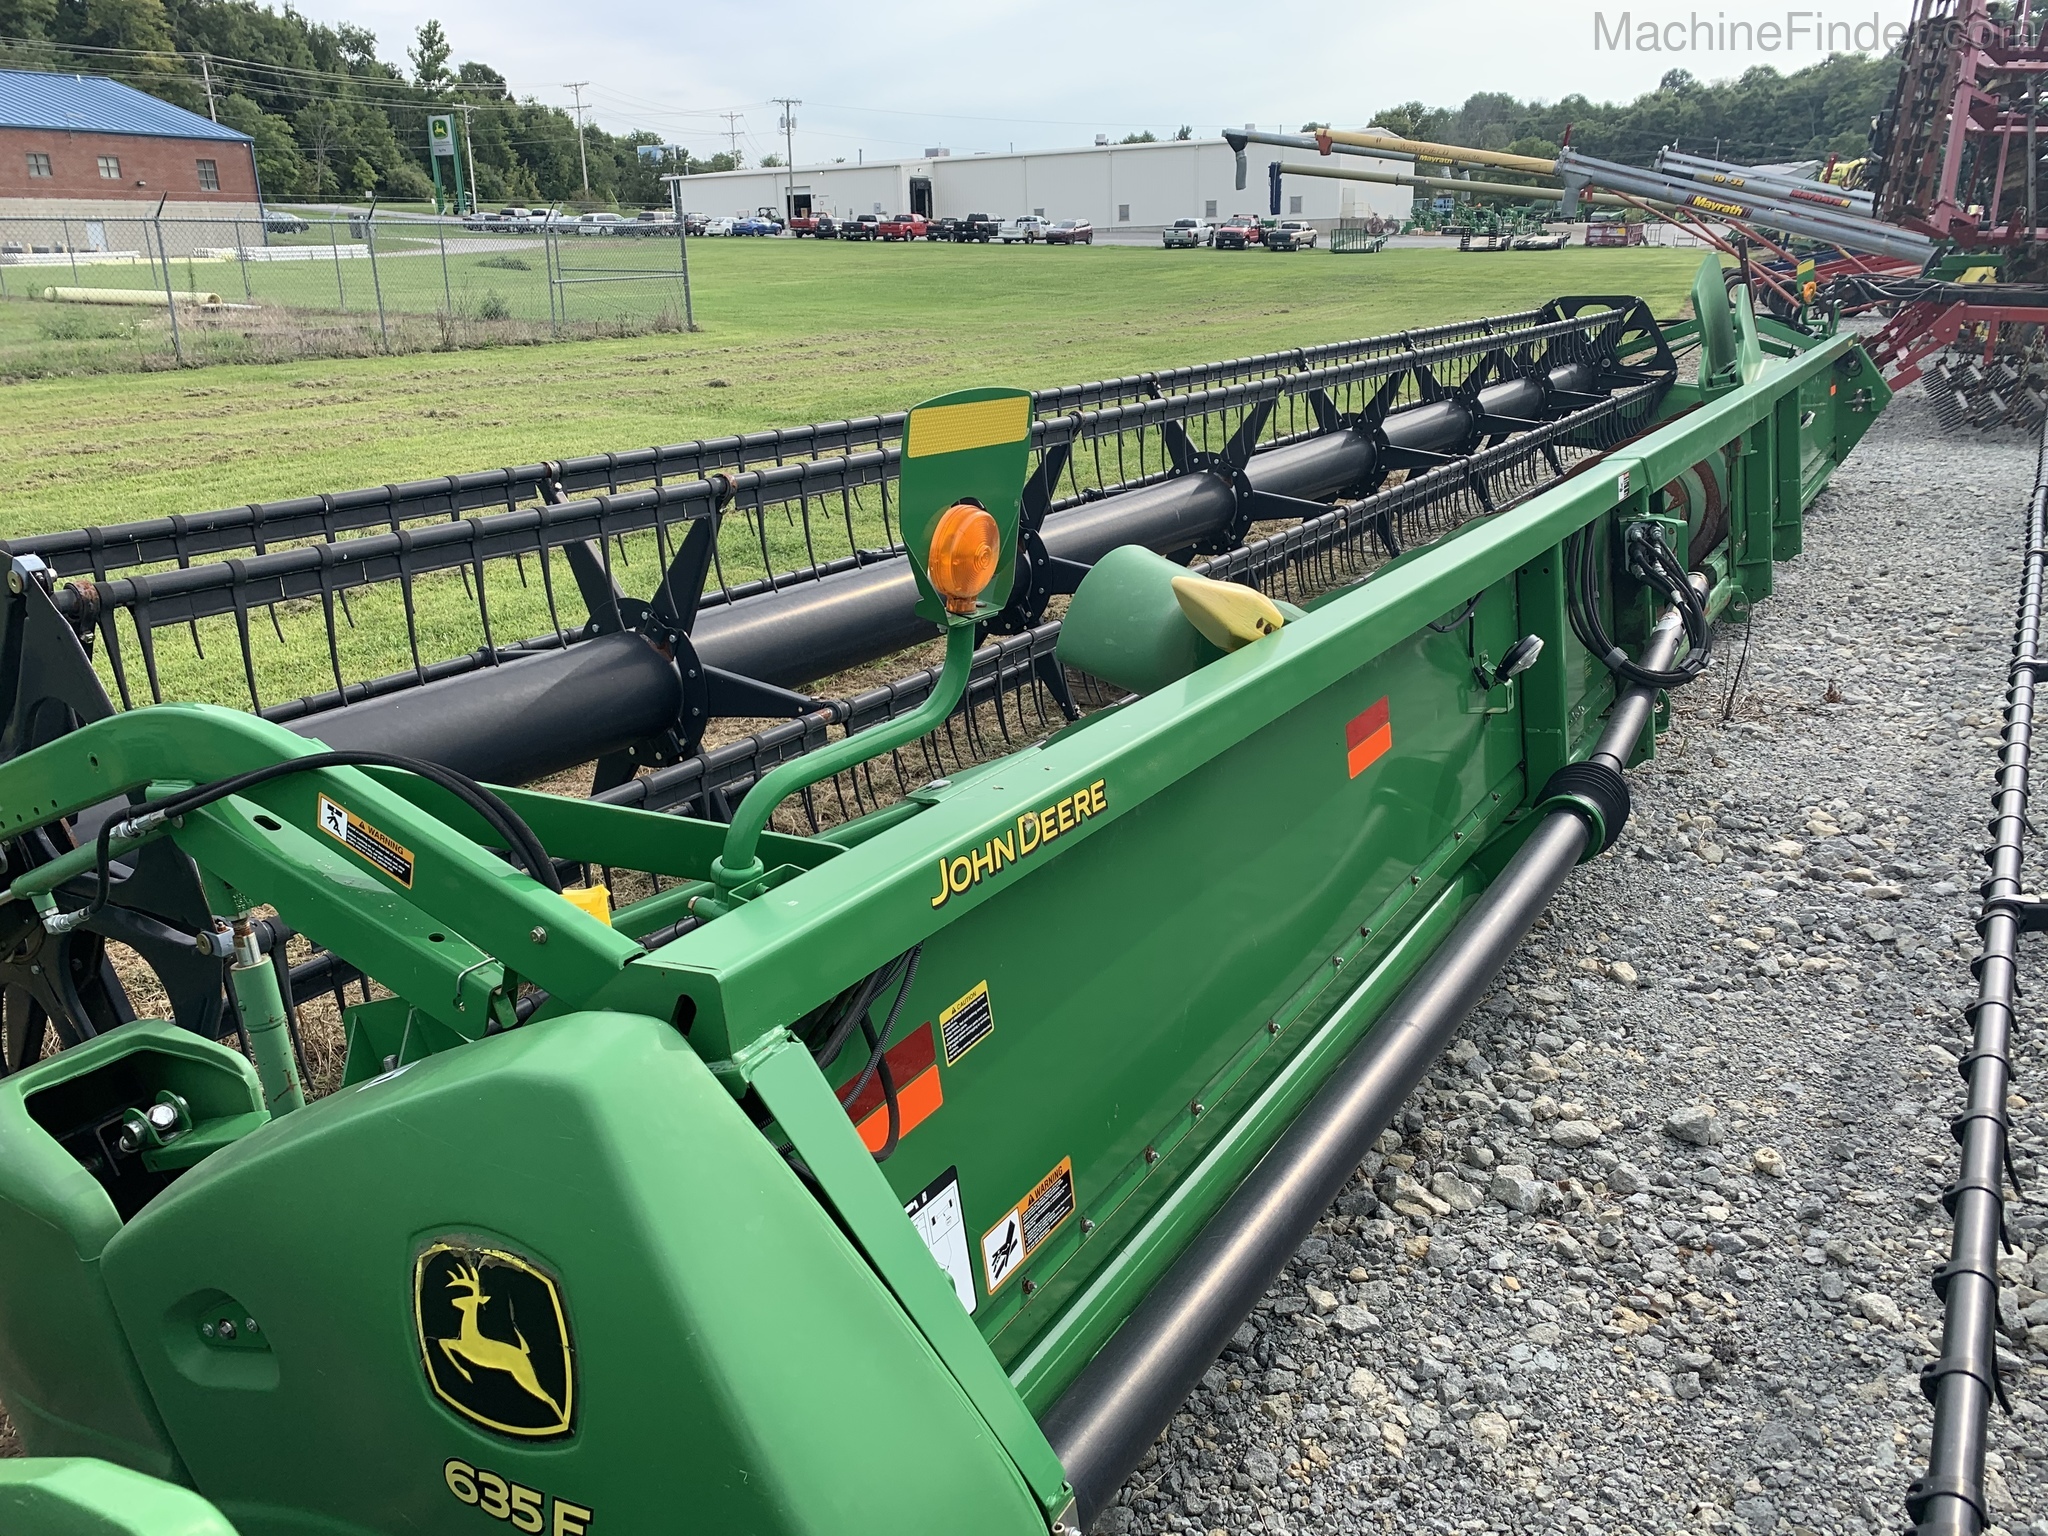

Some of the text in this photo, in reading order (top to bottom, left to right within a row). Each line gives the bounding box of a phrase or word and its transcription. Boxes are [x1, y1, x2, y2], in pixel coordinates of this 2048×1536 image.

[1419, 154, 1453, 165] Mayrath
[1692, 195, 1743, 217] Mayrath
[368, 825, 405, 856] WARNING
[931, 778, 1108, 909] JOHN DEERE
[956, 991, 977, 1011] CAUTION
[1034, 1165, 1063, 1199] WARNING
